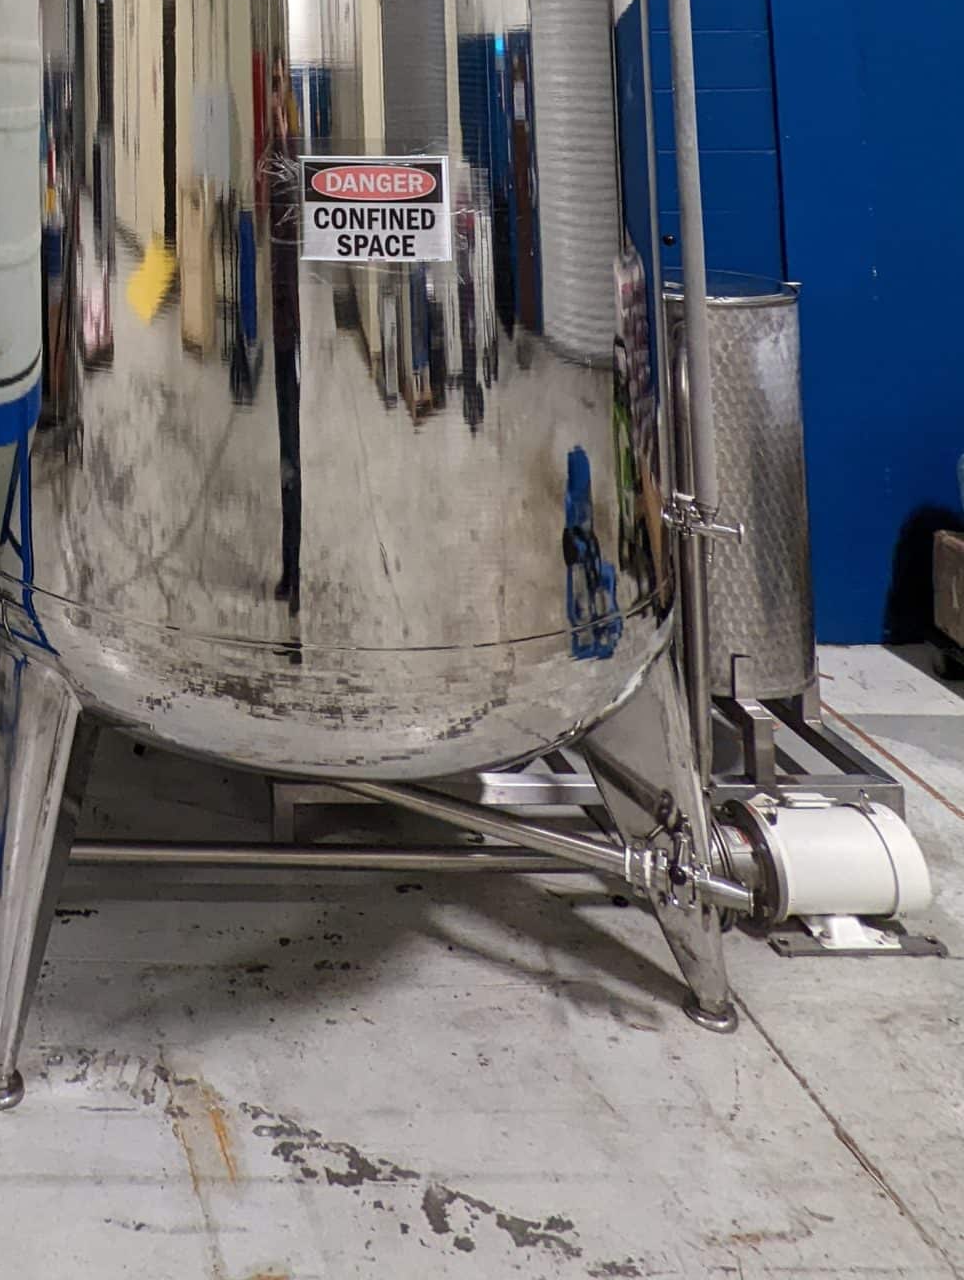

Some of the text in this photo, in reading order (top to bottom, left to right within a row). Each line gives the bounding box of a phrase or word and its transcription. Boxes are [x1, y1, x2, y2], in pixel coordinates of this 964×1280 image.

[325, 173, 424, 193] DANGER
[314, 207, 436, 231] CONFINED
[337, 234, 416, 257] SPACE
